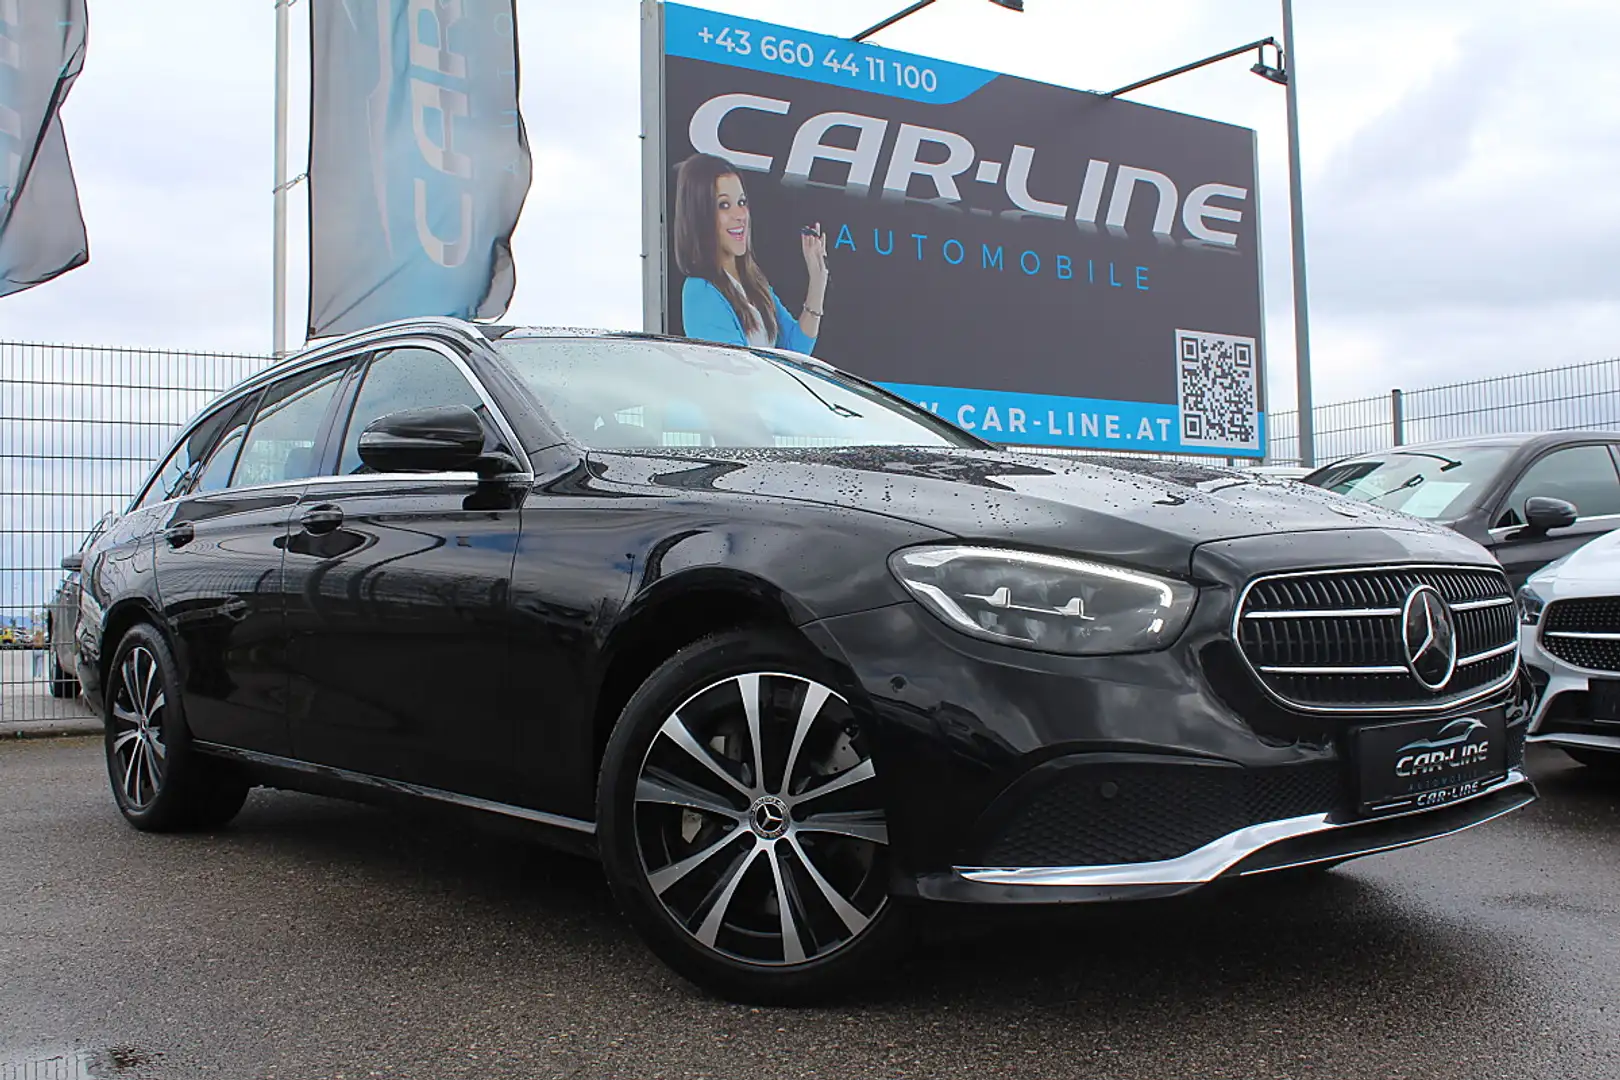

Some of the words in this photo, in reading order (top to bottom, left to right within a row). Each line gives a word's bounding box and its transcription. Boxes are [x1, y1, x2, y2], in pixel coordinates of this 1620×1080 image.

[698, 27, 751, 55] +43
[761, 36, 814, 67] 660
[823, 49, 859, 77] 44
[865, 56, 885, 82] 11
[893, 62, 937, 92] 100
[835, 224, 1150, 290] AUTOMOBILE
[919, 401, 1171, 442] CAR-LINE.AT
